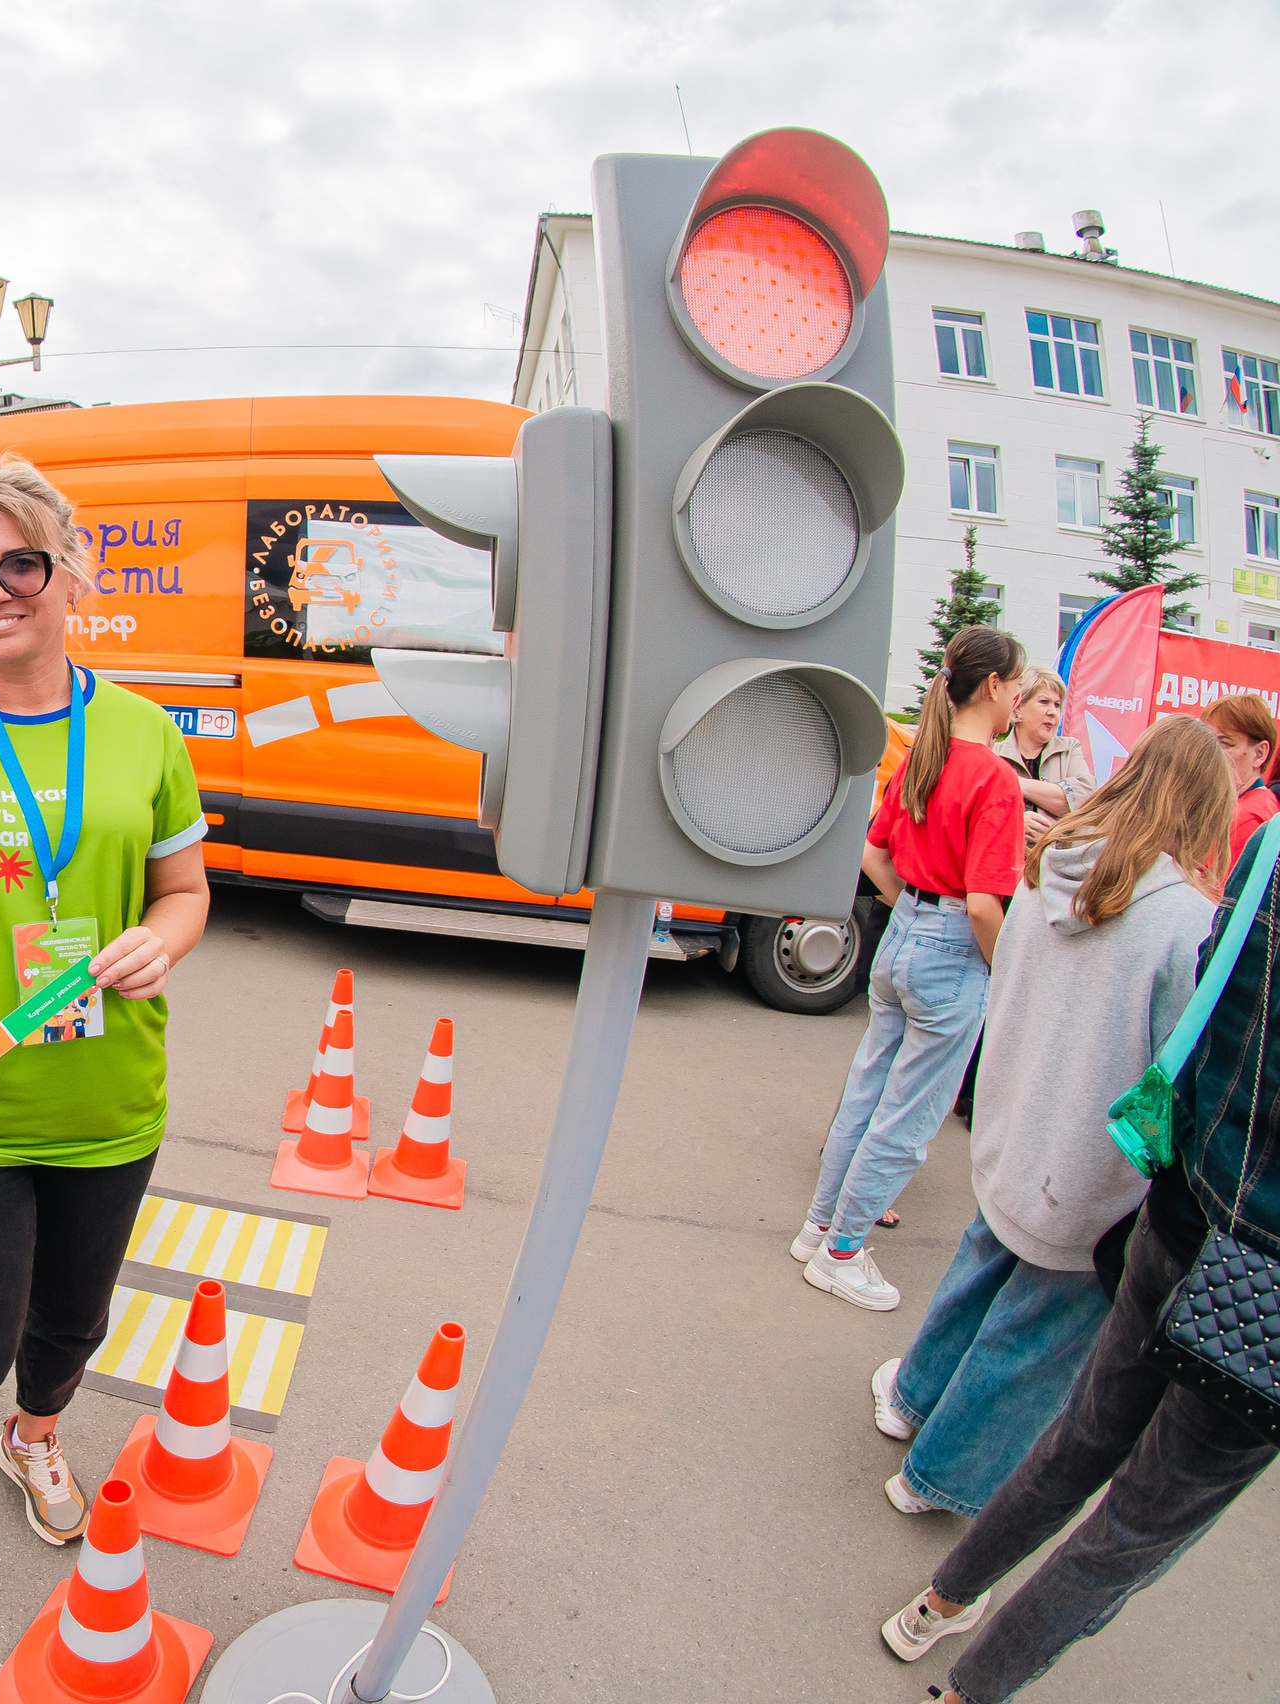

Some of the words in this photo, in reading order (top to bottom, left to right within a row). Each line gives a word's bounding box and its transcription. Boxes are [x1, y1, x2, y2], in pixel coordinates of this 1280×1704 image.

[252, 503, 398, 569] ЛАБОРАТОРИЯ
[201, 713, 230, 731] РФ
[27, 996, 55, 1019] Хорошая
[56, 975, 82, 999] реакция
